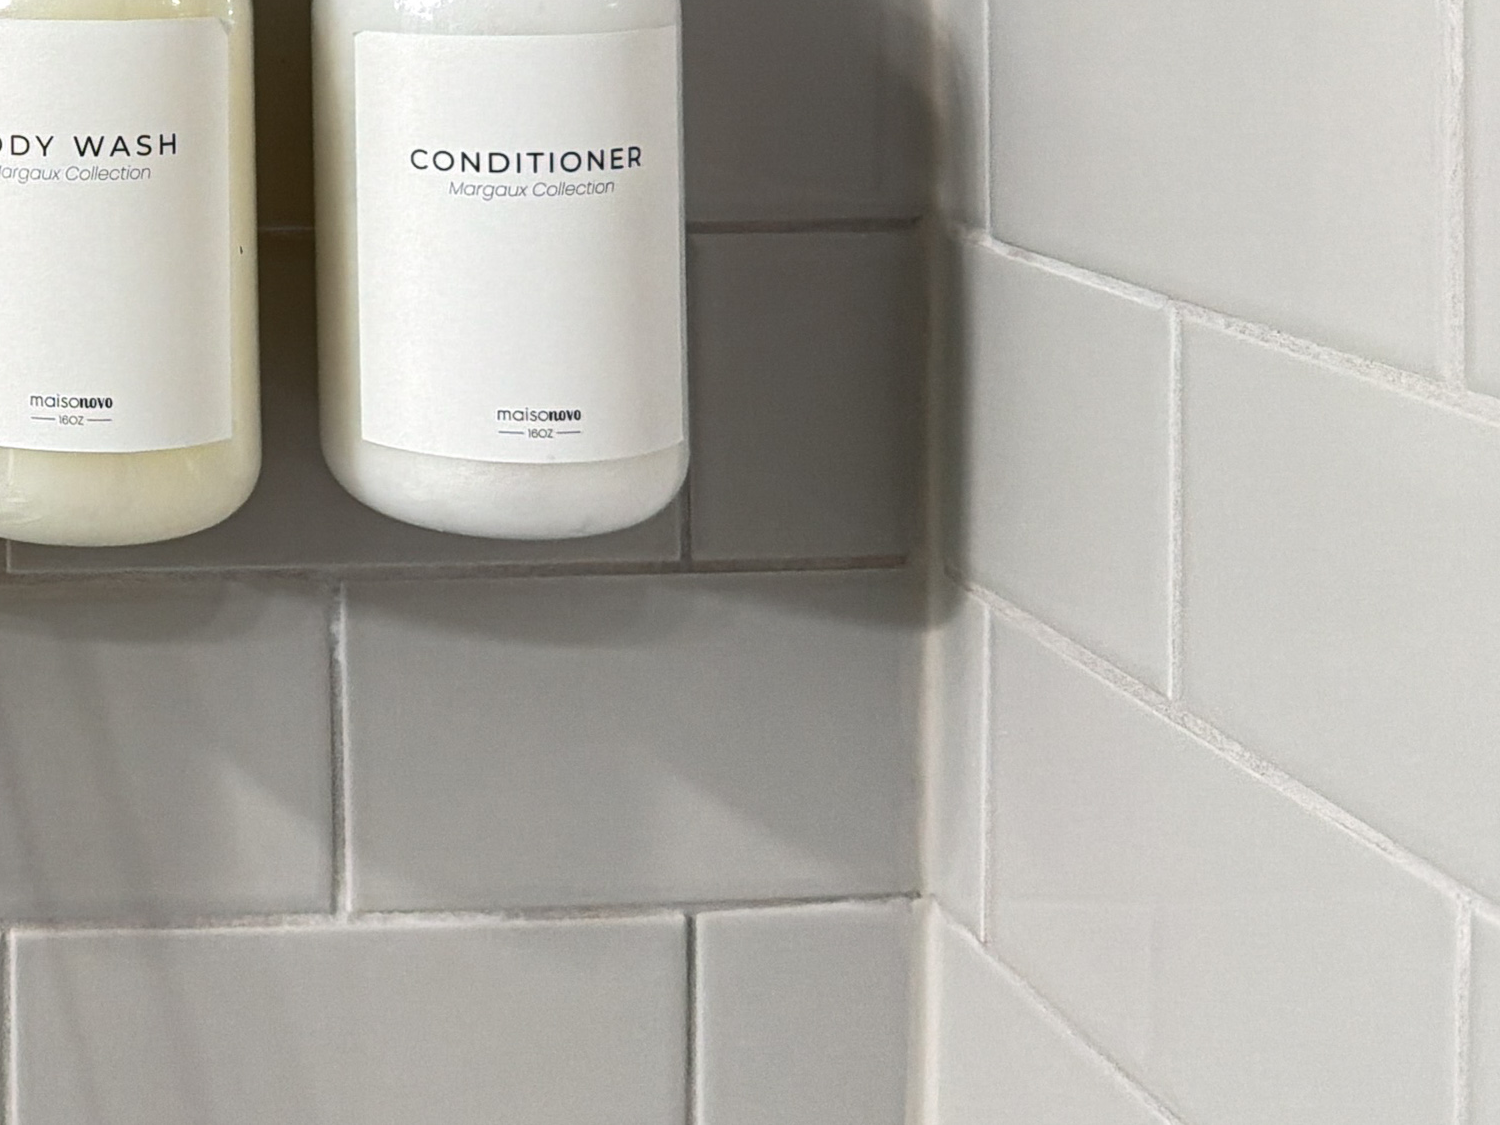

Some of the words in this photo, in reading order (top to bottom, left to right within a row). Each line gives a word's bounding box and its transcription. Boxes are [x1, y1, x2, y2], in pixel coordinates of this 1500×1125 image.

[73, 133, 176, 157] WASH
[410, 146, 641, 173] CONDITIONER
[65, 165, 151, 181] Collection
[449, 182, 528, 201] Margaux
[533, 182, 614, 197] Collection
[30, 394, 113, 409] maisonovo
[497, 407, 581, 422] maisonovo
